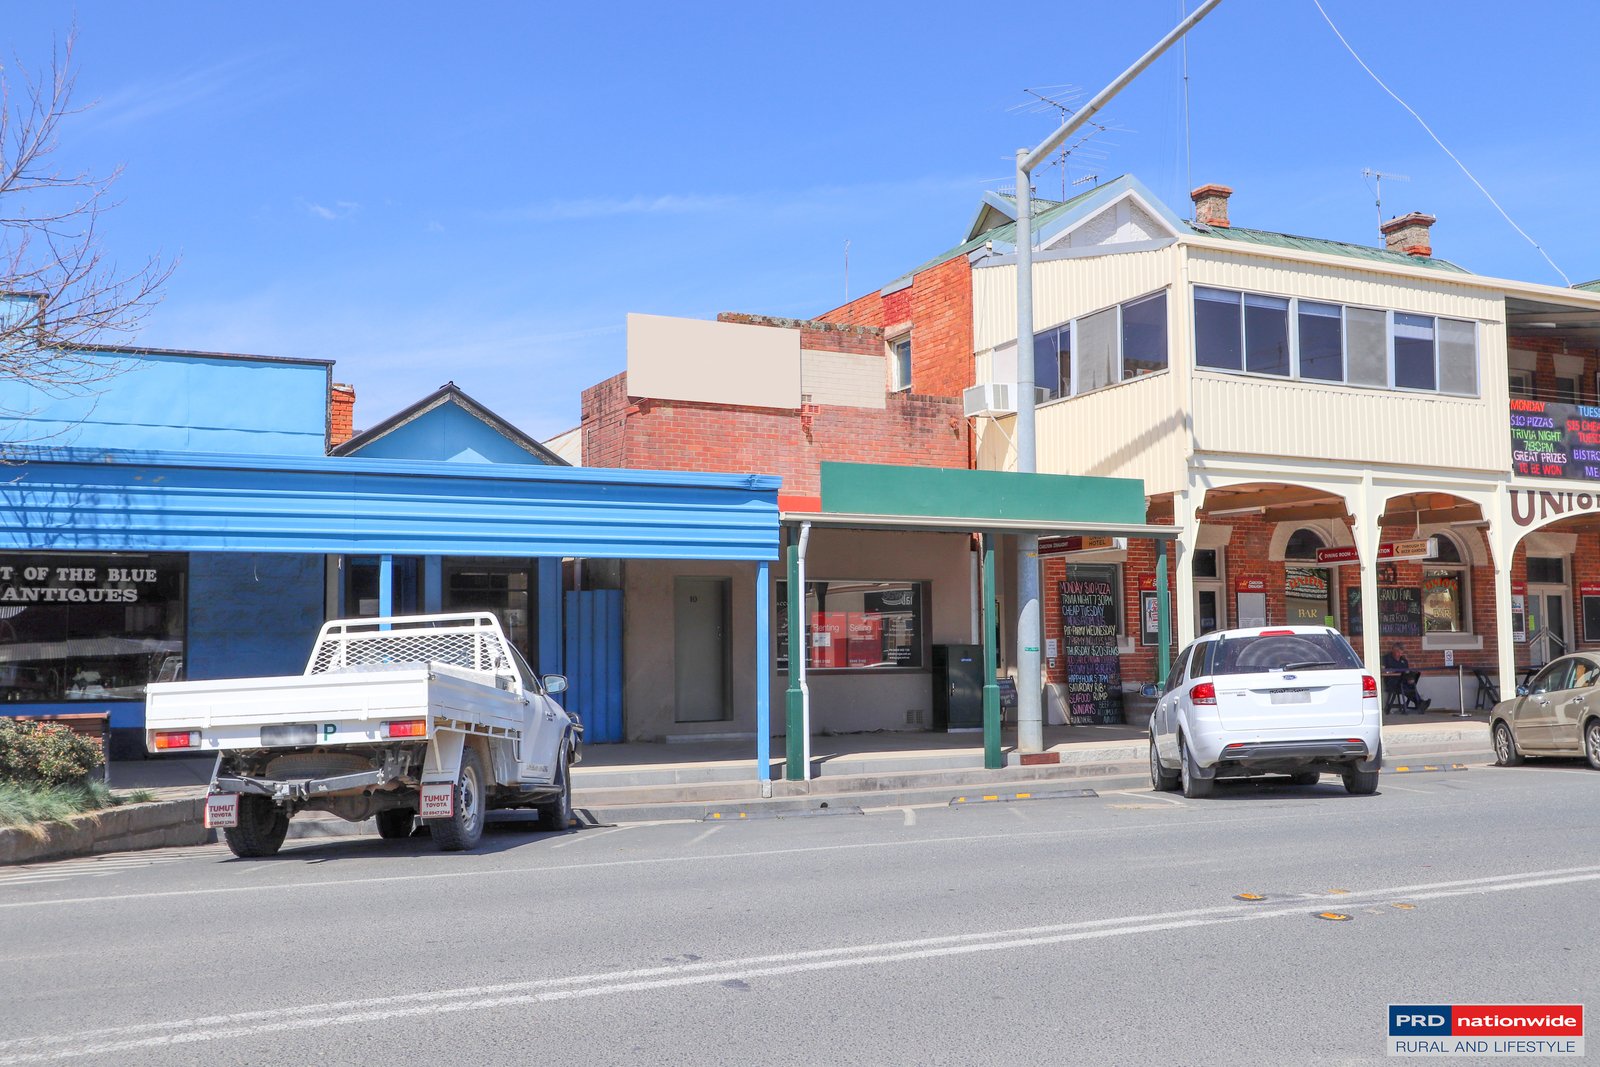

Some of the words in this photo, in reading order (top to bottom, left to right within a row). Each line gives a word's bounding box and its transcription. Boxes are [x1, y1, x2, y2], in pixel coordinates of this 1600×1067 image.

[1510, 399, 1546, 412] MONDAY
[1577, 406, 1600, 418] TUES
[1510, 414, 1525, 426] $10
[1527, 416, 1554, 428] PIZZAS
[1511, 428, 1537, 440] TRIVIA
[1538, 430, 1561, 442] NIGHT
[1513, 450, 1538, 462] GREAT
[1541, 452, 1567, 464] PRIZES
[1519, 462, 1528, 473] TO
[1531, 463, 1540, 475] BE
[1543, 464, 1562, 475] WON
[1585, 465, 1600, 478] ME
[24, 567, 49, 581] OF
[56, 568, 96, 581] THE
[108, 568, 157, 583] BLUE
[0, 587, 138, 602] ANTIQUES
[1378, 589, 1398, 600] GRAND
[1062, 605, 1080, 616] CHEAP
[1080, 605, 1104, 617] TUESDAY
[1298, 609, 1317, 618] BAR
[1433, 608, 1450, 618] BAR
[812, 624, 840, 633] Renting
[849, 624, 872, 634] Selling
[1086, 625, 1116, 637] WEDNESDAY
[1066, 645, 1090, 656] THURSDAY
[1091, 645, 1103, 657] $20
[1068, 682, 1093, 692] SATURDAY
[1069, 692, 1091, 704] SEAFOOD
[1093, 691, 1108, 701] RUMP
[1073, 703, 1096, 715] SUNDAYS
[323, 723, 337, 742] P
[424, 794, 450, 802] TUMUT
[209, 804, 235, 812] TUMUT
